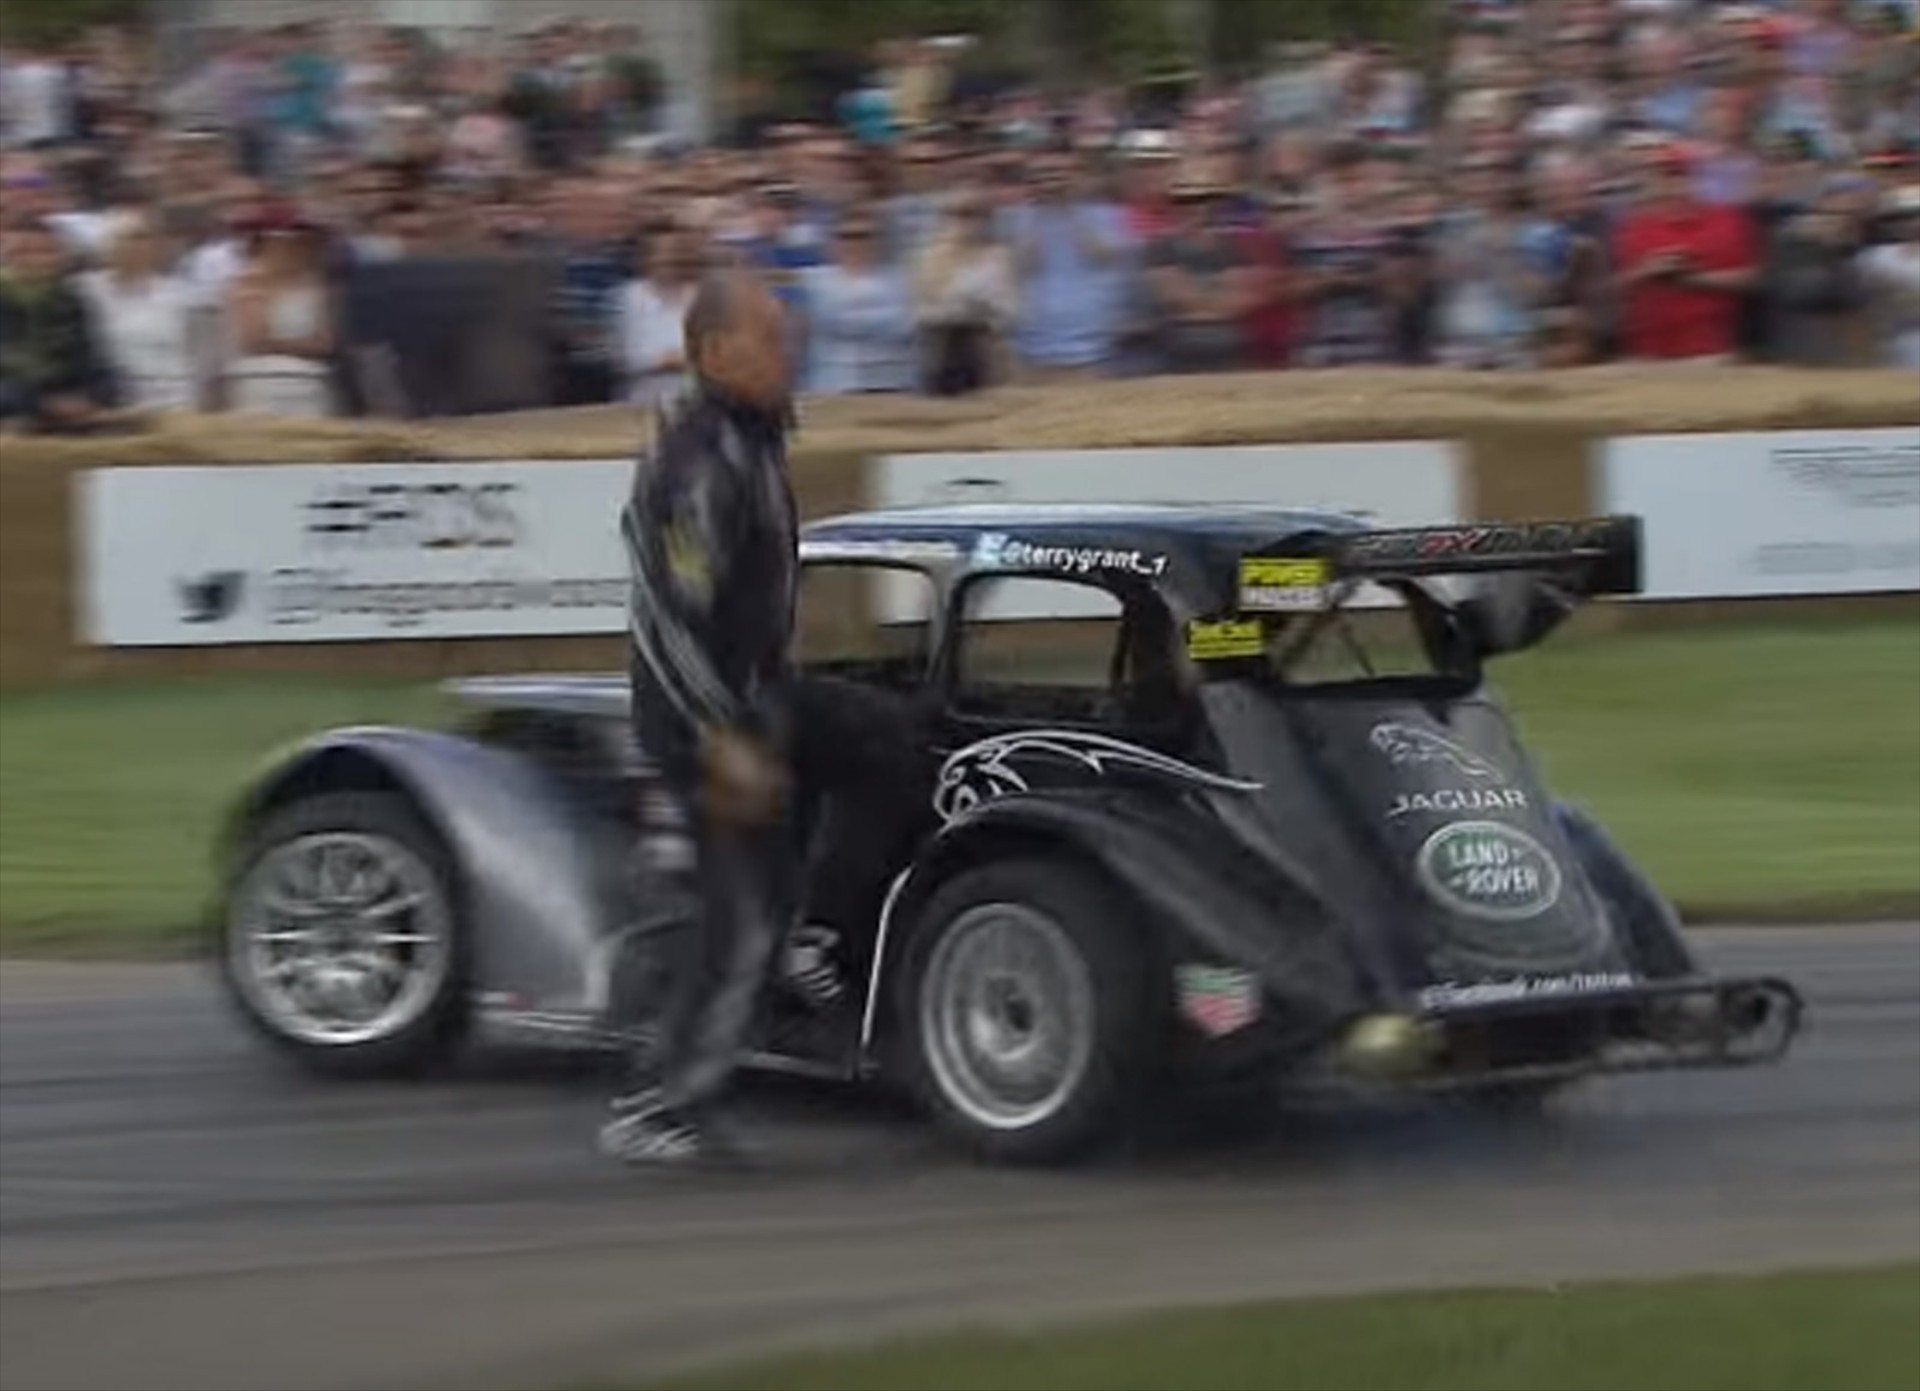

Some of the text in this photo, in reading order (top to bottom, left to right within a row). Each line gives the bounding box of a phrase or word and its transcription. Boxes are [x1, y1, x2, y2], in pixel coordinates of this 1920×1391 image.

[1003, 541, 1167, 575] @terrygrant_1
[1387, 789, 1527, 817] JAGUAR
[1450, 841, 1508, 867] LAND
[1467, 867, 1540, 893] ROVER
